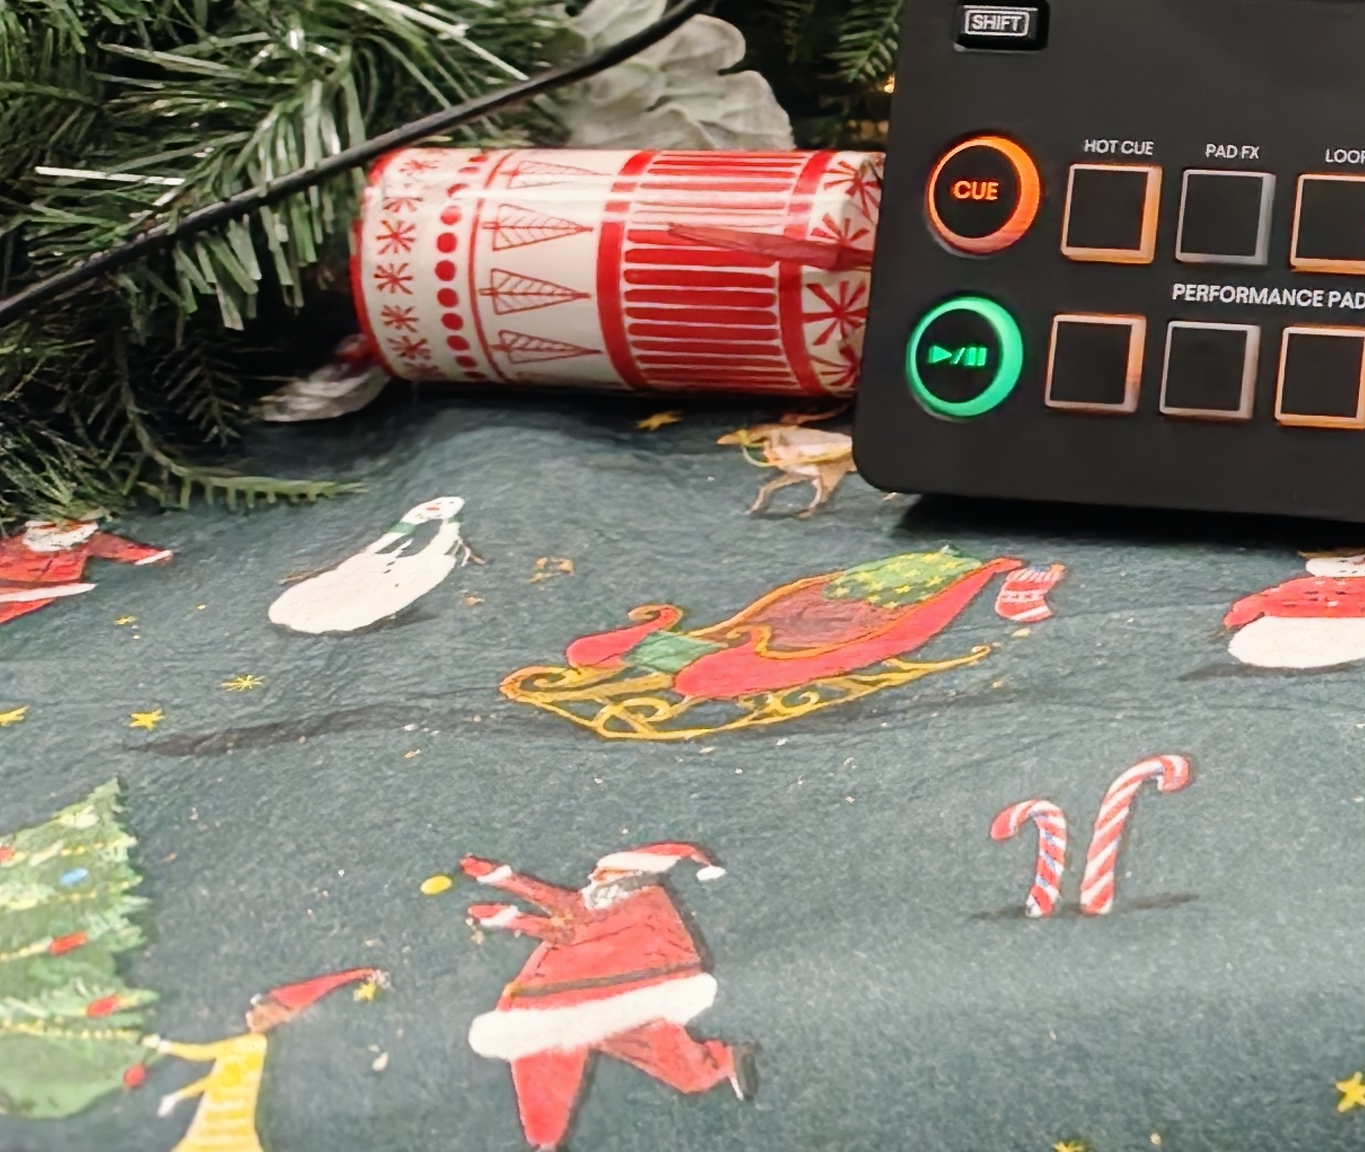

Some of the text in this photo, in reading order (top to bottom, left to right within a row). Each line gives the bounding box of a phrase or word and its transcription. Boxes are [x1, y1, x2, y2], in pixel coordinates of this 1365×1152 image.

[971, 14, 1022, 32] SHIFT
[1083, 139, 1154, 156] HOT CUE
[1205, 143, 1260, 160] PAD FX
[951, 180, 999, 201] CUE
[1172, 283, 1325, 307] PERFORMANCE
